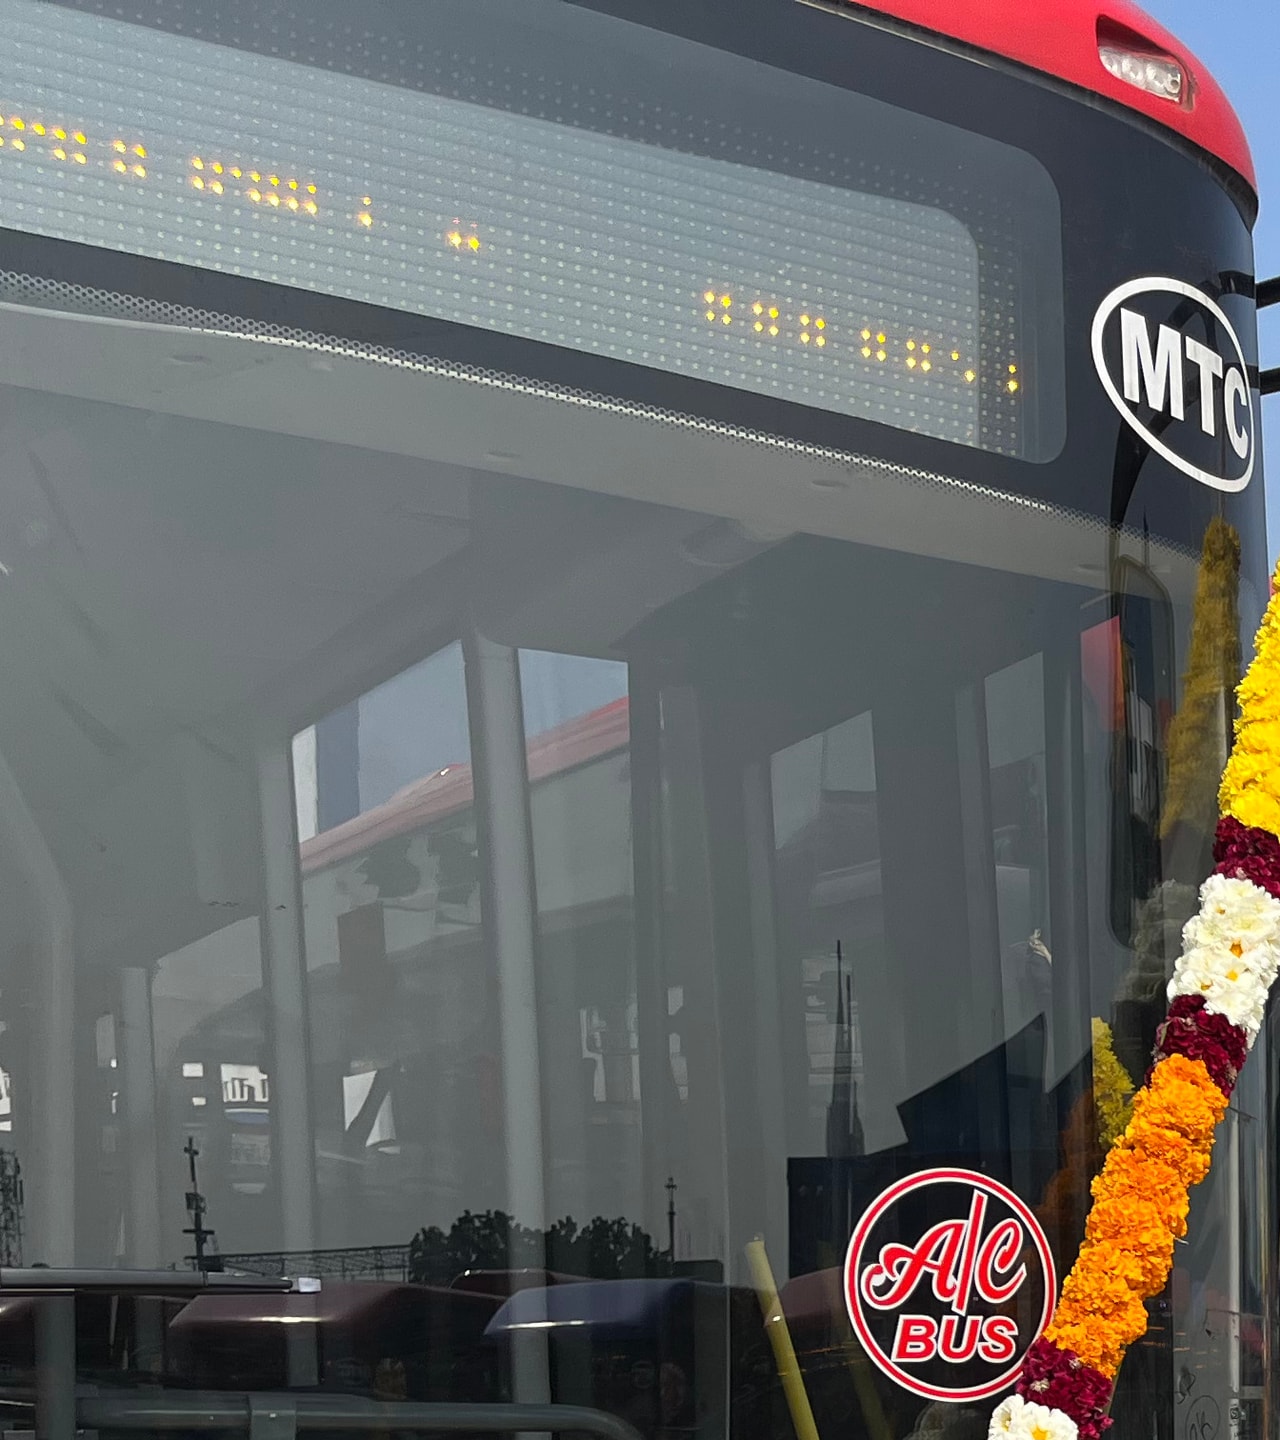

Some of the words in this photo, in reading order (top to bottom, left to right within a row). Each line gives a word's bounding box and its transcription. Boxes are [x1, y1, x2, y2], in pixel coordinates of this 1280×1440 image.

[1120, 307, 1248, 459] MTC
[860, 1188, 1027, 1316] A/C
[891, 1314, 1018, 1363] BUS
